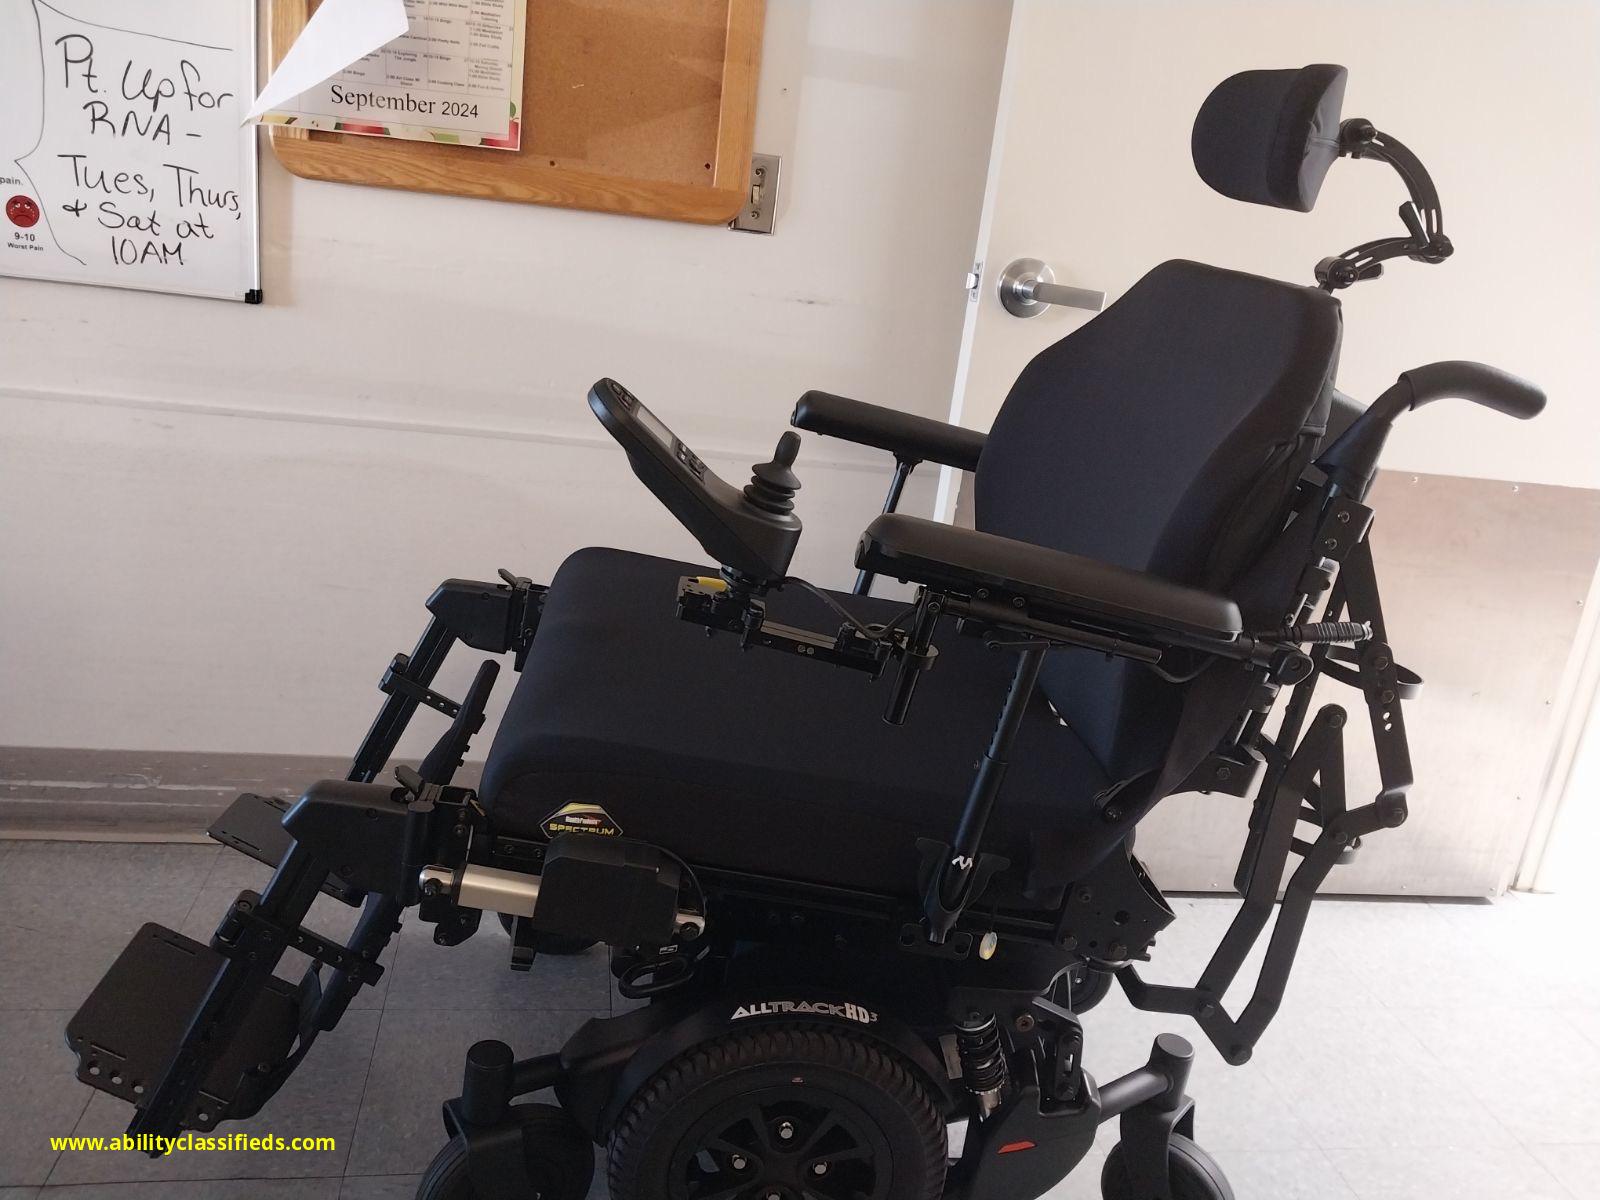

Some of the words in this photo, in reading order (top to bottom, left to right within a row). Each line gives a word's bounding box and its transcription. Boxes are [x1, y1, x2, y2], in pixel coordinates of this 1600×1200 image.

[121, 59, 175, 112] Up
[181, 59, 234, 111] for
[331, 84, 436, 114] September
[441, 101, 478, 118] 2024
[83, 100, 171, 145] RNA
[57, 154, 155, 202] Tues,
[163, 164, 241, 220] Thurs,
[14, 232, 36, 242] 9-10
[98, 201, 161, 236] Sat
[176, 213, 214, 239] at
[7, 242, 27, 250] Worst
[112, 235, 184, 266] 10AM
[549, 823, 614, 836] SPECTRUM
